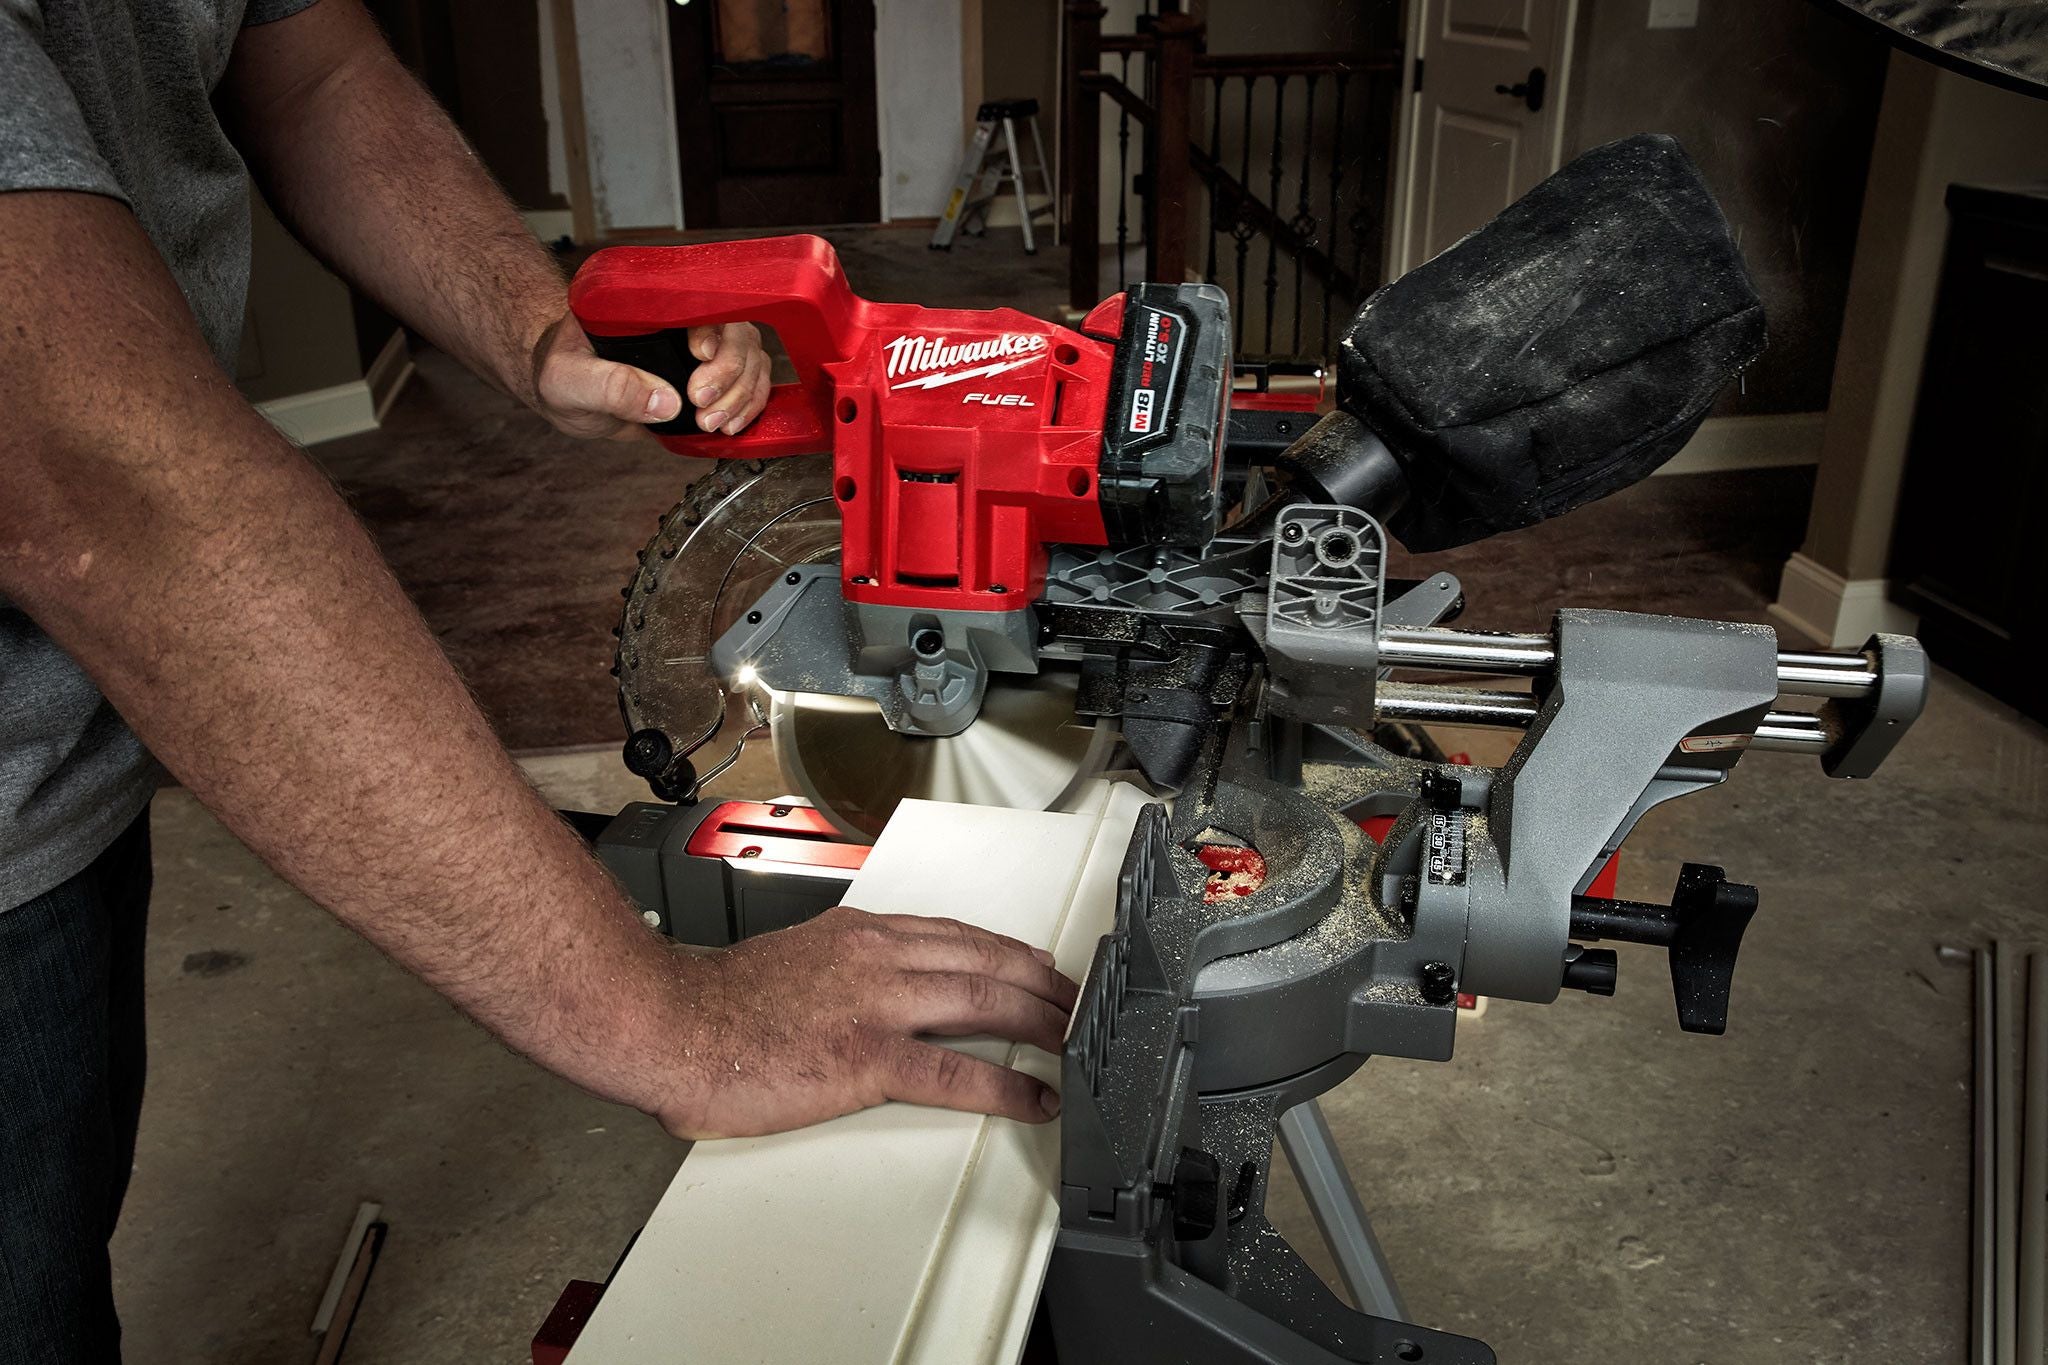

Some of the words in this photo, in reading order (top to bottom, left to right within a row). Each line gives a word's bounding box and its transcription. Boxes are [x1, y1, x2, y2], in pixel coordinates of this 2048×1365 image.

[883, 334, 1048, 378] Milwaukee
[962, 393, 1035, 407] FUEL
[1134, 392, 1150, 430] M18
[1434, 835, 1443, 847] 30
